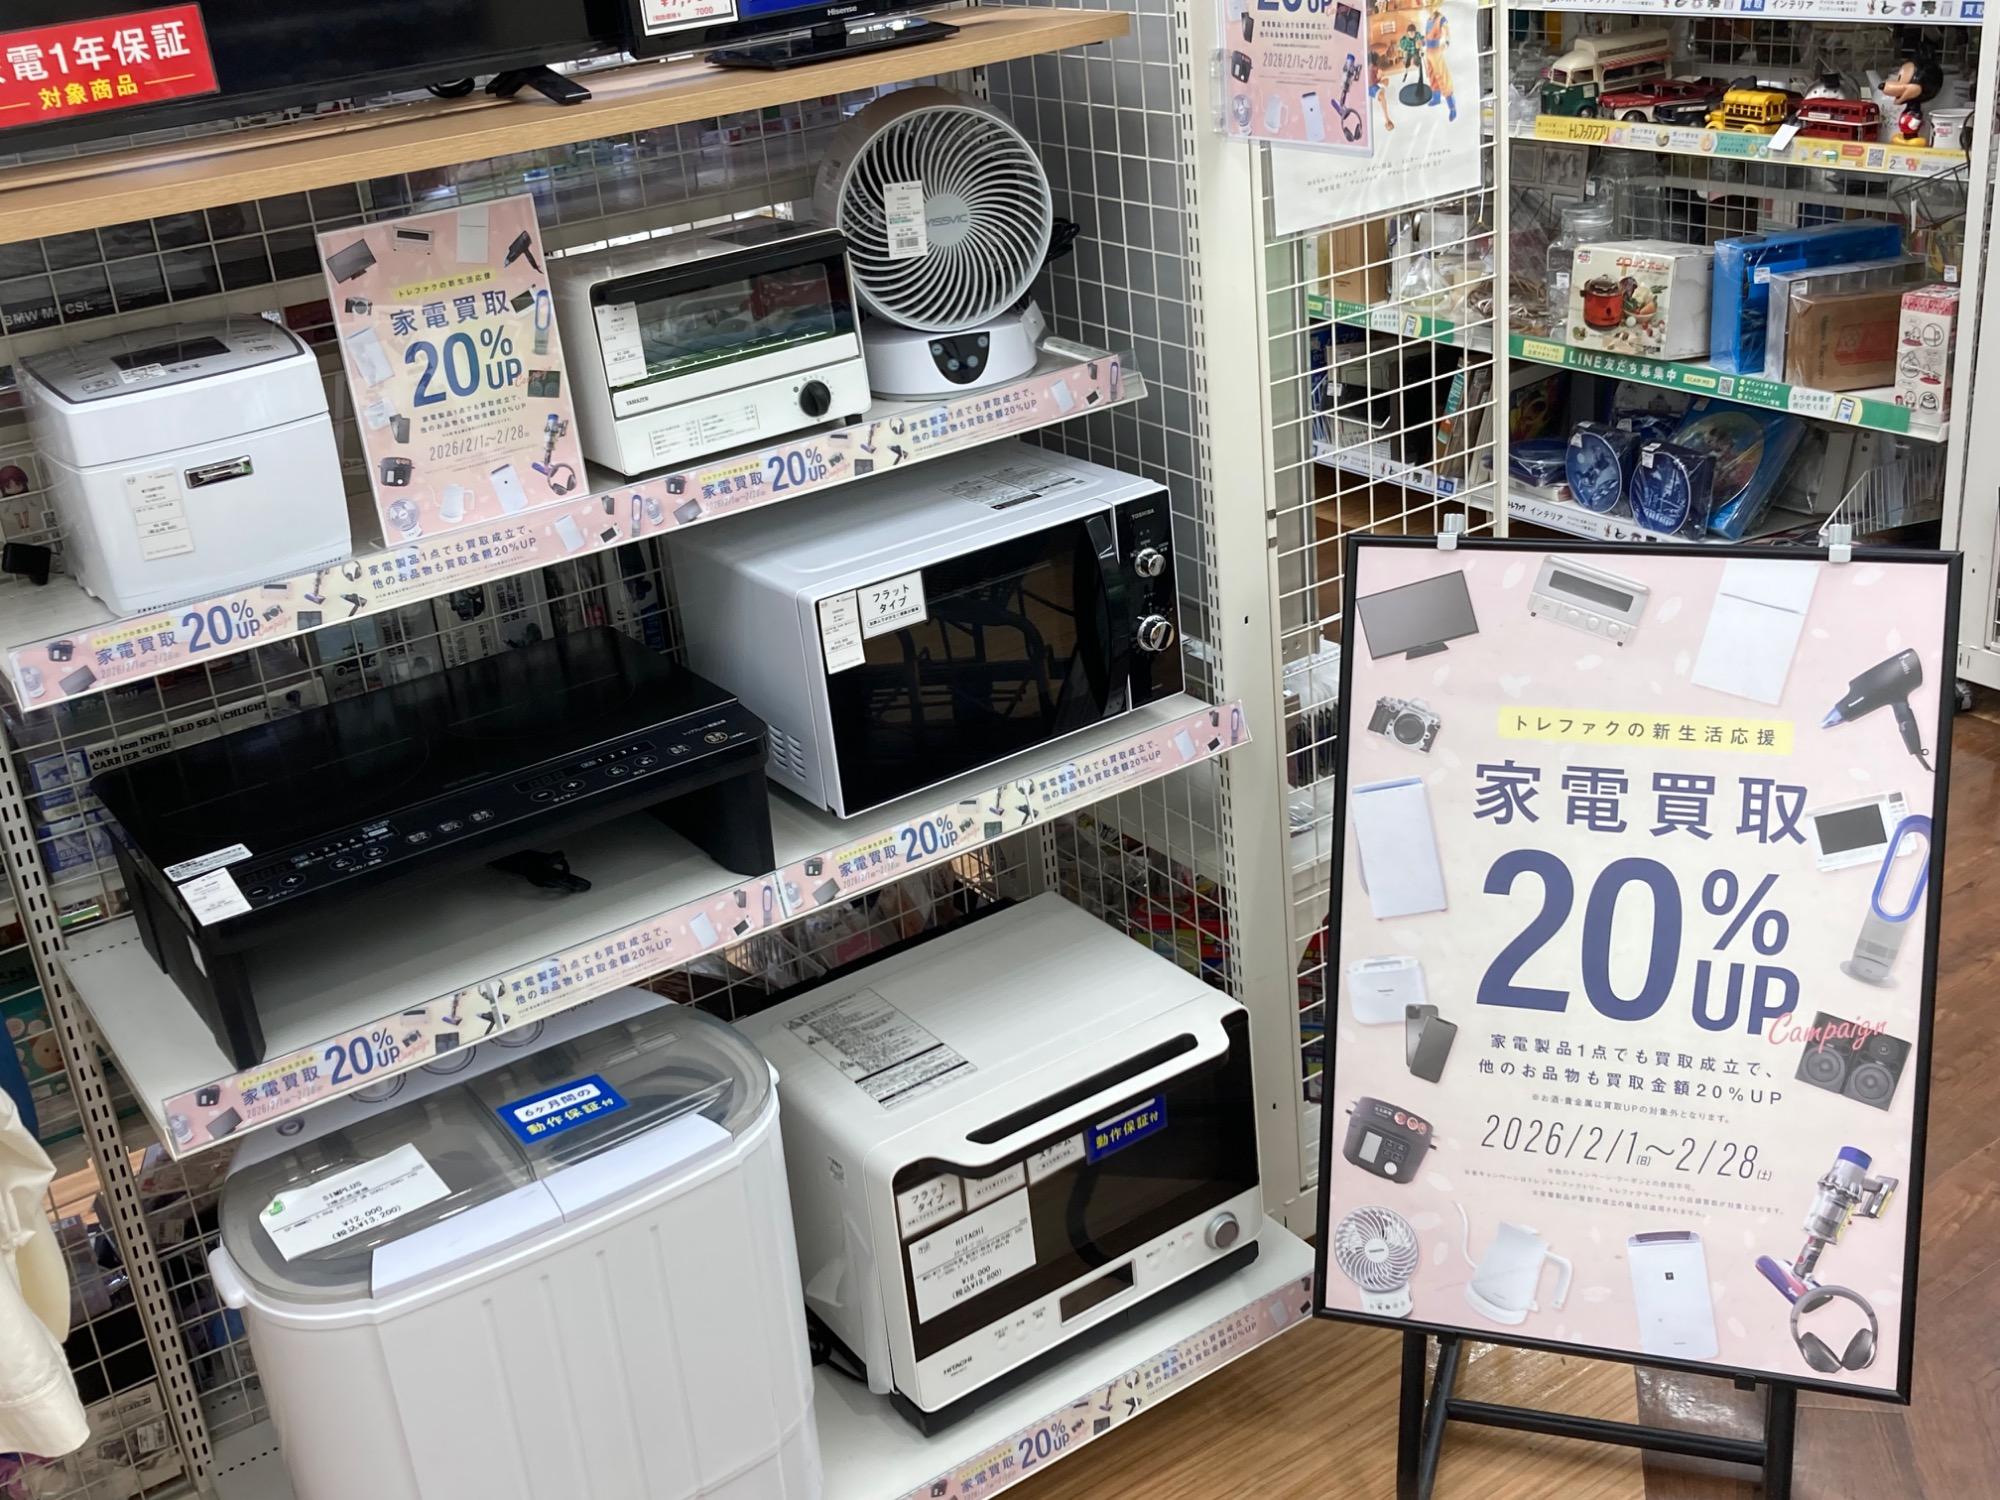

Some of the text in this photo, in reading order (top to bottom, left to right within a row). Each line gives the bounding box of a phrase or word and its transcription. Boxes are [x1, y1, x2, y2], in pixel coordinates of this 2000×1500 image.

[827, 5, 858, 16] Hisense
[0, 20, 190, 84] 電1年保証
[38, 74, 138, 110] 対象商品
[65, 302, 94, 315] CSL
[390, 290, 510, 336] 家電買取
[701, 471, 764, 499] 家電買取
[1131, 508, 1155, 520] TOSHIBA
[368, 526, 533, 577] 家電製品1点でも買取成立で、
[372, 537, 537, 590] 他のお品物も買取金額20%UP
[873, 583, 910, 603] フラット
[879, 597, 907, 614] タイプ
[95, 631, 178, 667] 家電買取
[1516, 715, 1776, 746] トレファクの新生活応援
[1473, 759, 1808, 845] 家電買取
[838, 845, 897, 878] 家電買取
[512, 928, 668, 992] 家電製品1点でも買取成立で、
[515, 938, 672, 1006] 他のお品物も買取金額20%UP
[1768, 1009, 1889, 1054] Campaign
[1491, 1033, 1775, 1079] 家電製品1点でも買取成立で、
[241, 1065, 320, 1106] 家電買取
[1479, 1058, 1783, 1106] 他のお品物も買取金額20%UP
[526, 1097, 614, 1136] 動作保証付
[1095, 1111, 1159, 1149] 動作保証付
[322, 1180, 363, 1202] SIMPLUS
[955, 1226, 984, 1245] HITACHI
[943, 1356, 973, 1376] HITACHI
[961, 1455, 1015, 1493] 家電買取
